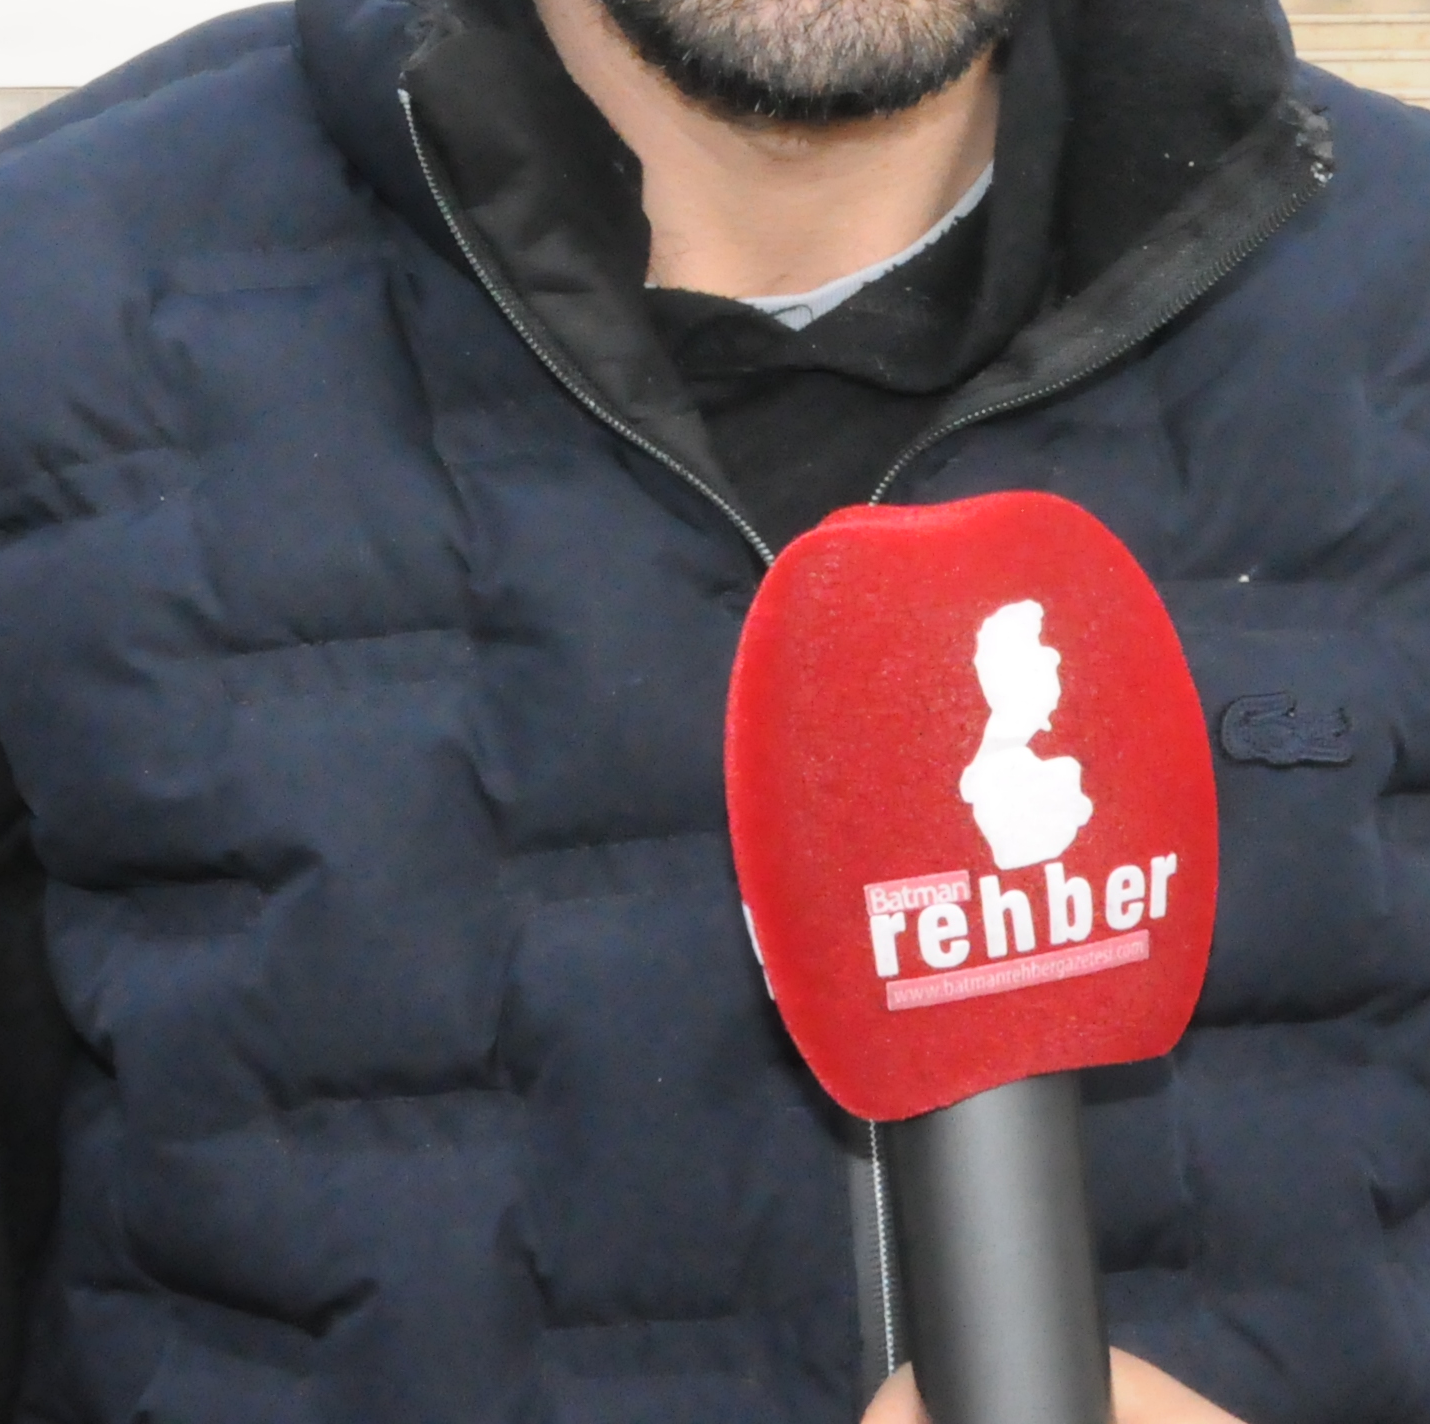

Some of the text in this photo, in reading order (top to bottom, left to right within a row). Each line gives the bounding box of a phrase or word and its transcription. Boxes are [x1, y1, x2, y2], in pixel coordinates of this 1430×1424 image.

[870, 878, 970, 913] Batman
[871, 852, 1177, 977] rehber
[893, 937, 1145, 1005] www.batmanrehbergazetesi.com
